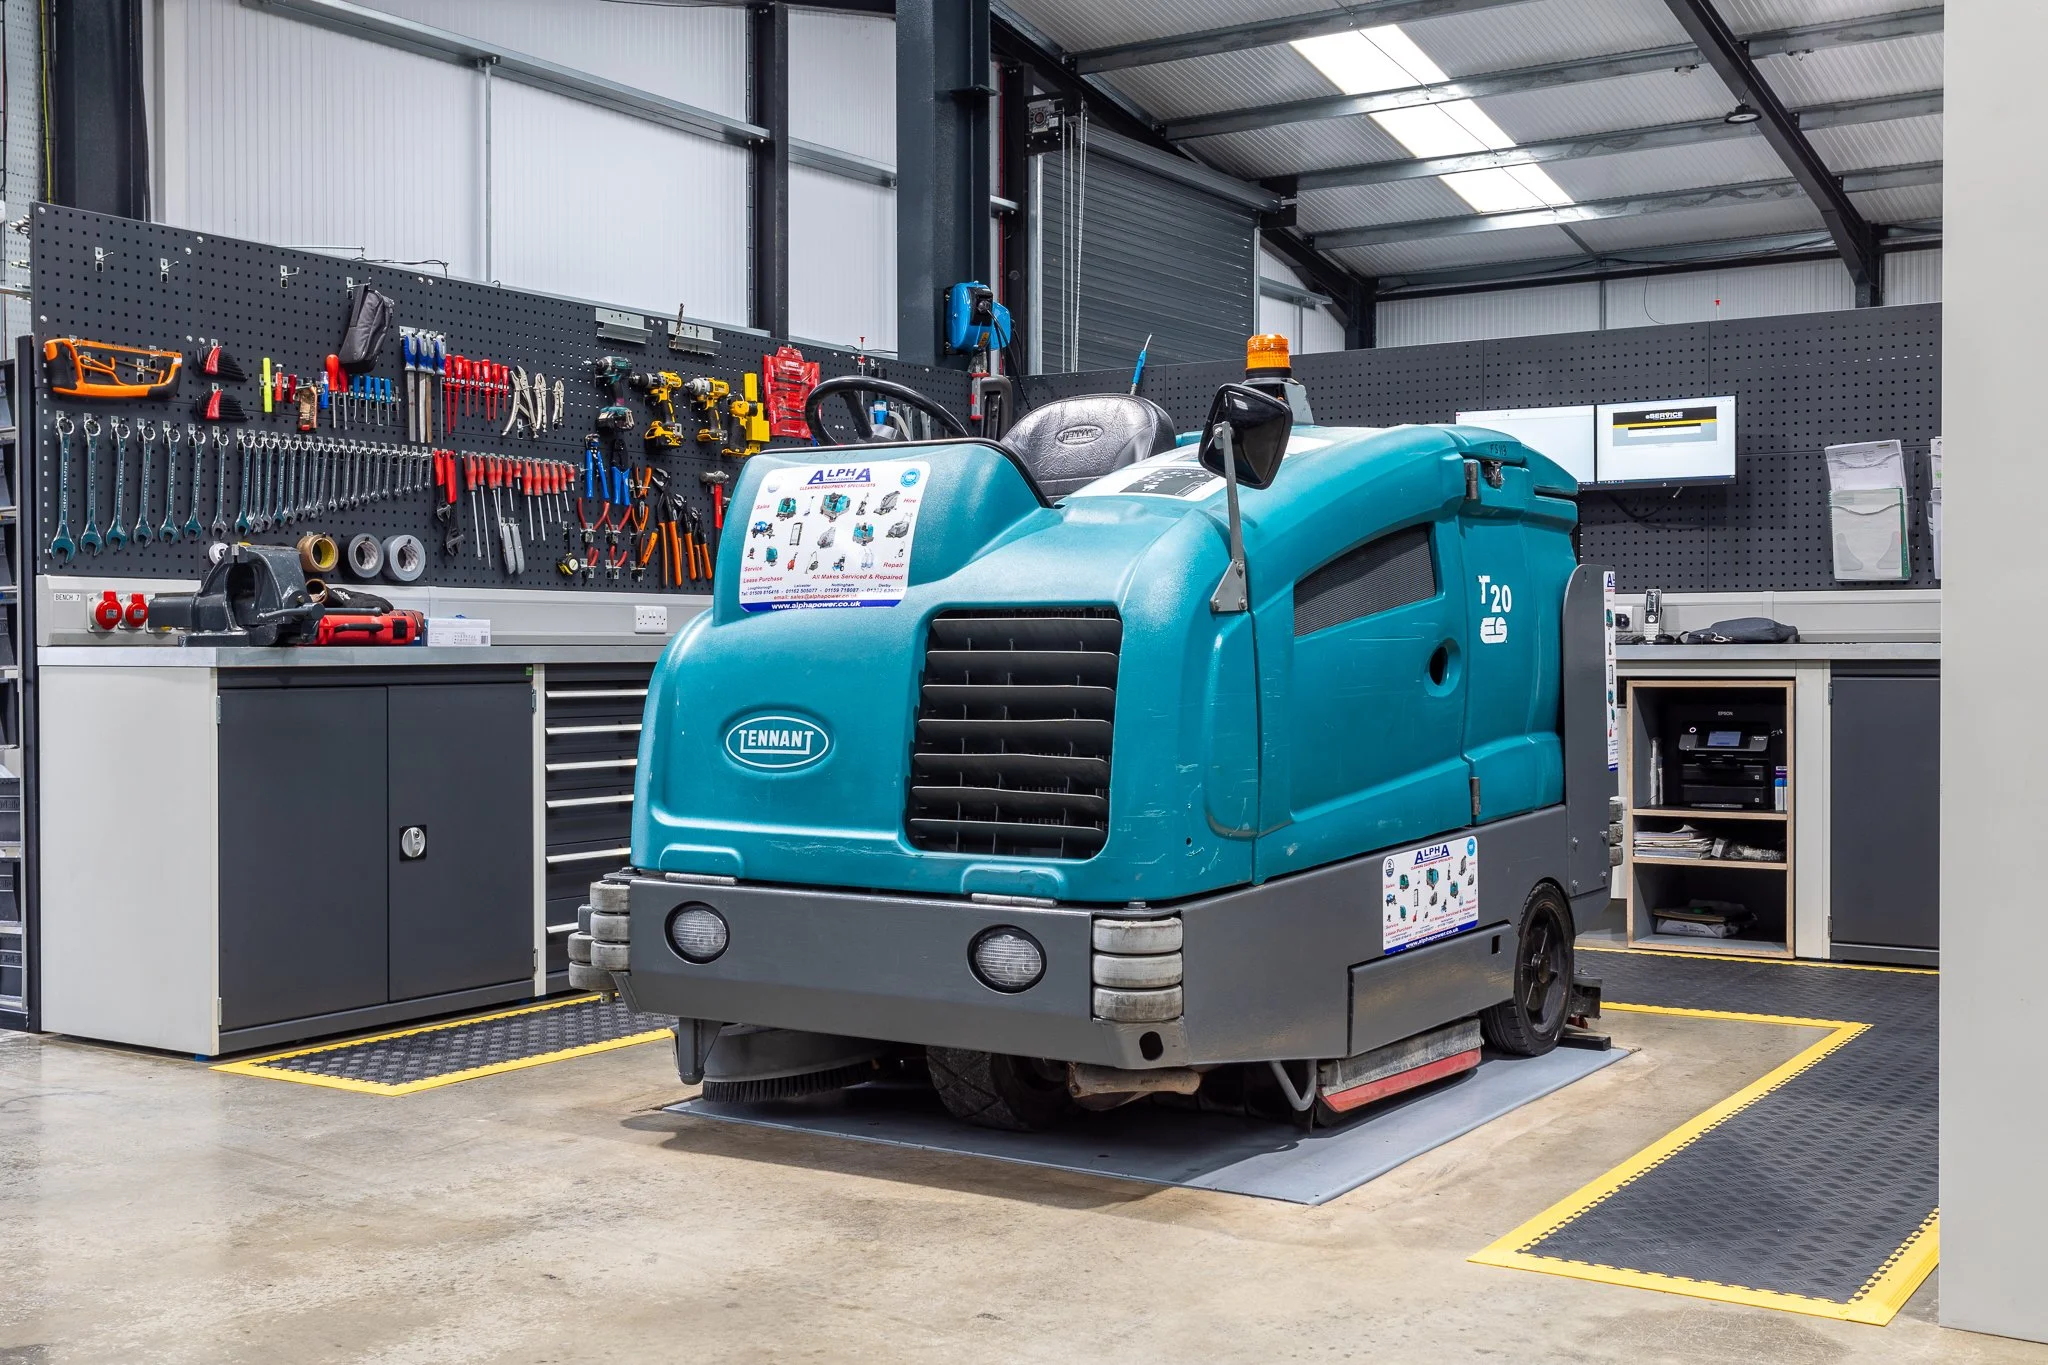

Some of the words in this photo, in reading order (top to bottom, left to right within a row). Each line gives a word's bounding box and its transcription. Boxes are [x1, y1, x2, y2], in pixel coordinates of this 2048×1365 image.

[1645, 411, 1683, 420] eSERVICE
[807, 467, 871, 485] ALPHA
[55, 593, 73, 601] BENCH
[1478, 575, 1512, 613] T20
[771, 600, 861, 609] www.alphapower.co.uk
[739, 730, 814, 755] TENNANT
[1414, 844, 1450, 866] ALPHA
